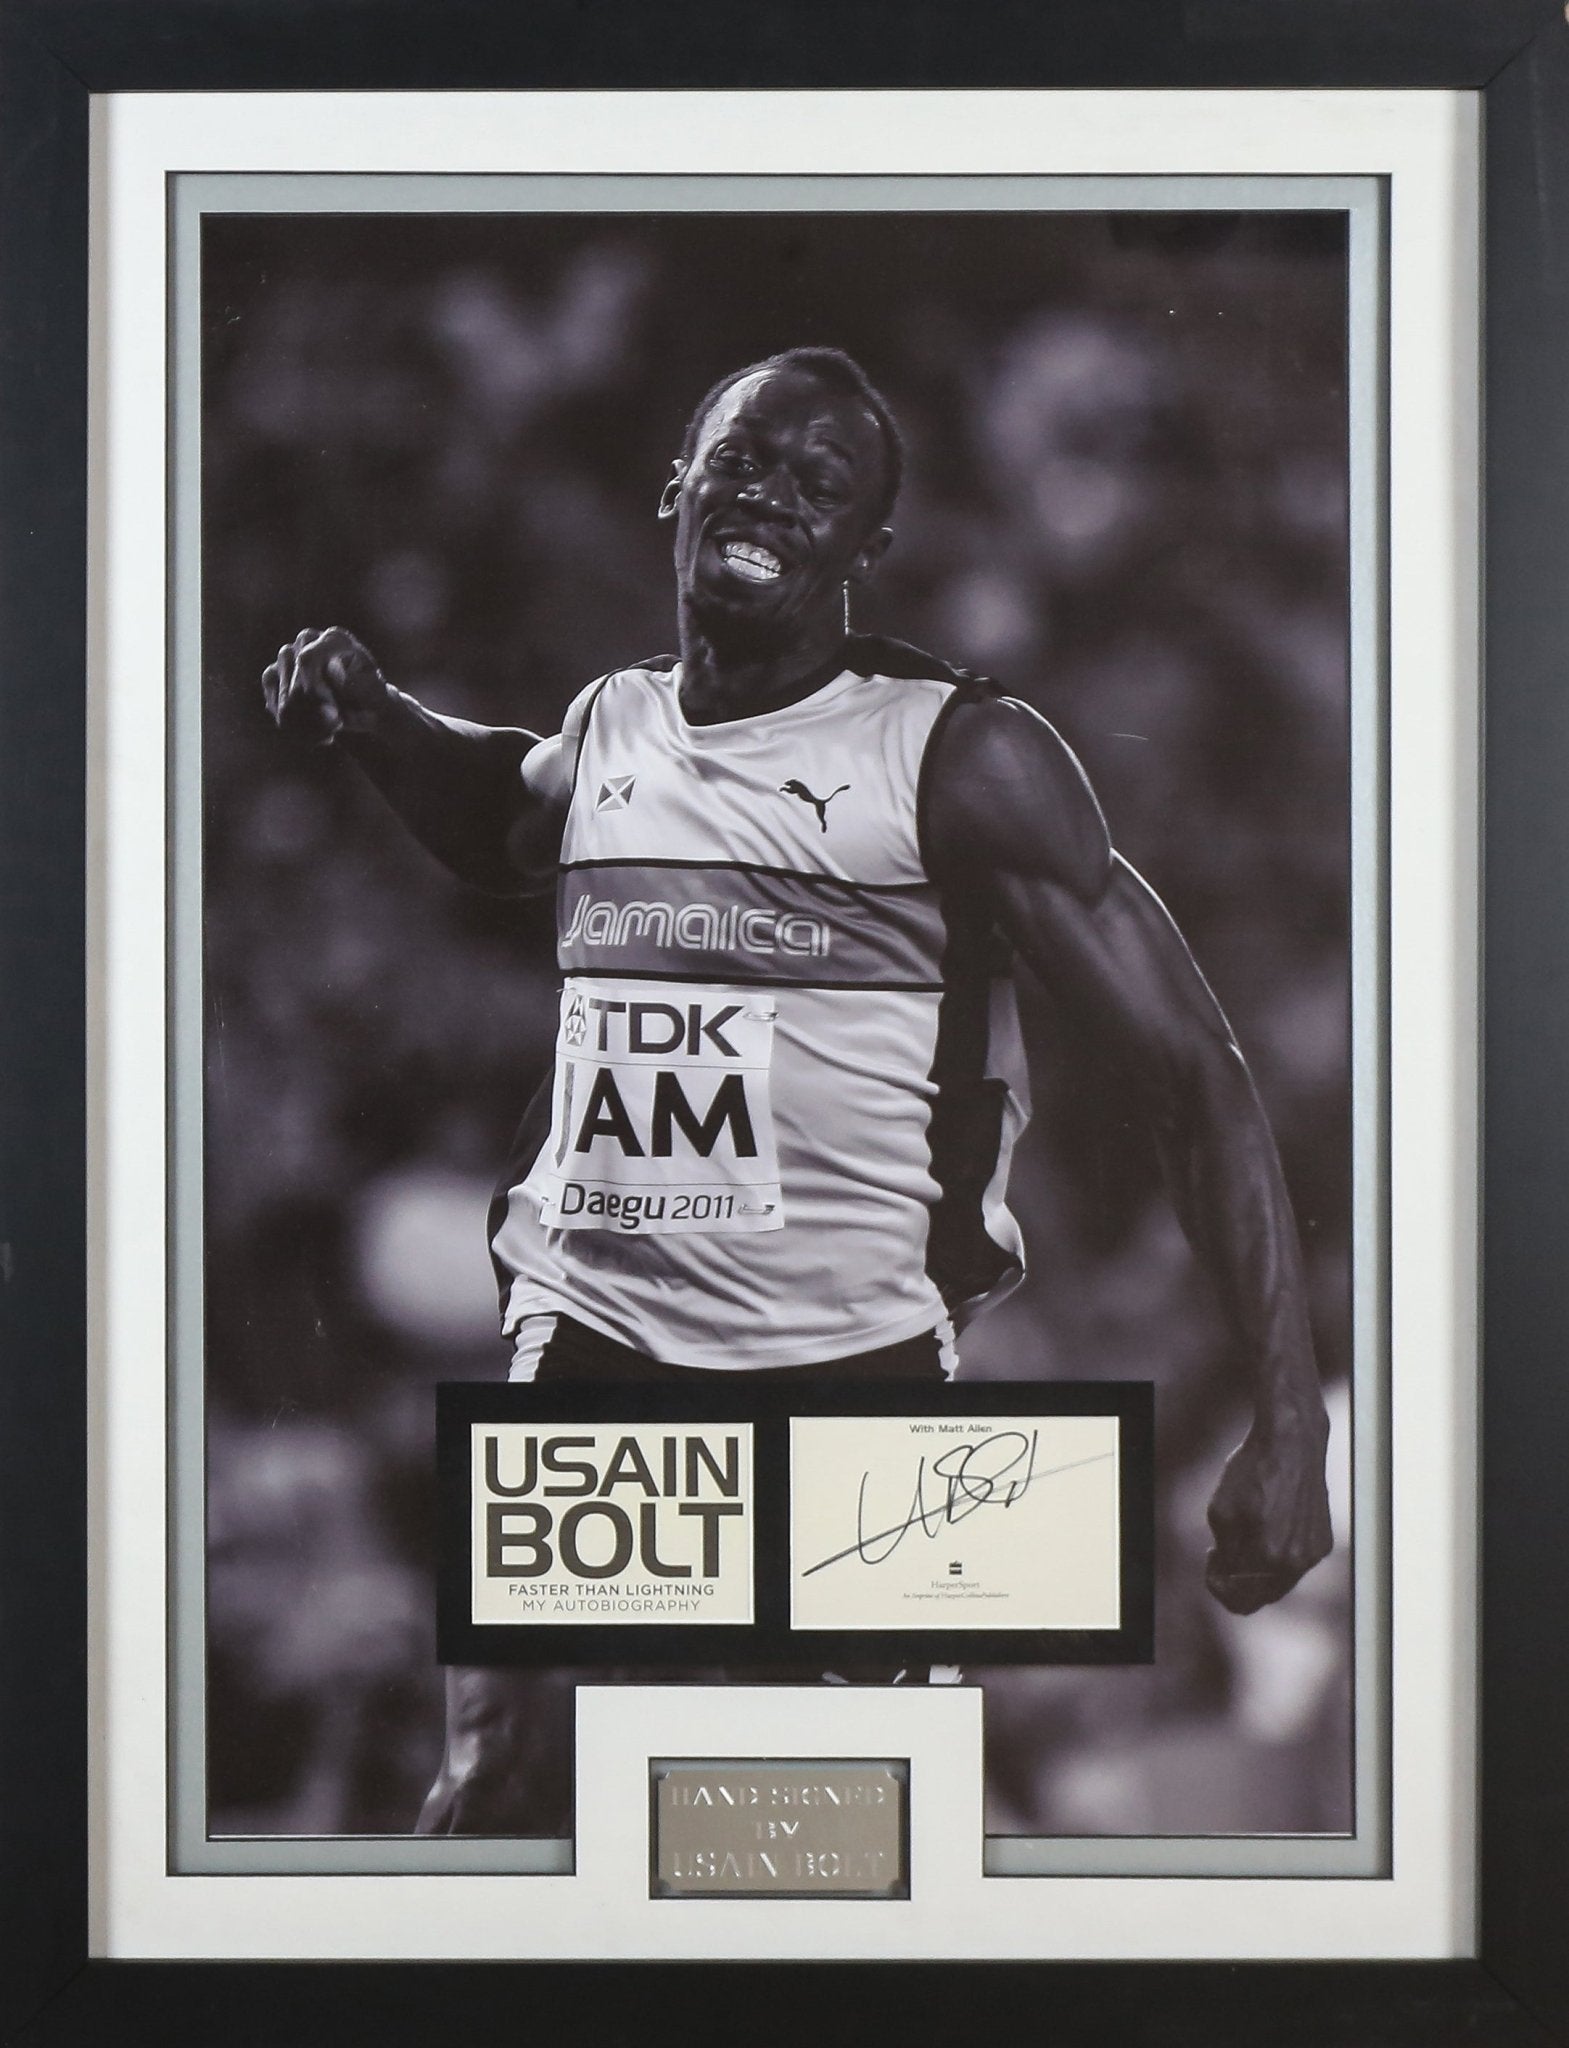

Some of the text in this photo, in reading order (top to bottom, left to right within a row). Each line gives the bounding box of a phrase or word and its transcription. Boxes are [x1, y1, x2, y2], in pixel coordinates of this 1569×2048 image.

[561, 894, 830, 957] Jamaica
[588, 998, 743, 1058] TDK
[559, 1182, 734, 1230] Daegu 2011
[909, 1424, 935, 1433] With
[938, 1424, 964, 1433] Matt
[485, 1436, 739, 1497] USAIN
[486, 1501, 744, 1579] BOLT
[508, 1584, 715, 1596] FASTER THAN LIGHTNING
[522, 1599, 701, 1612] MY AUTOBIOGRAPHY
[671, 1785, 759, 1806] HAND
